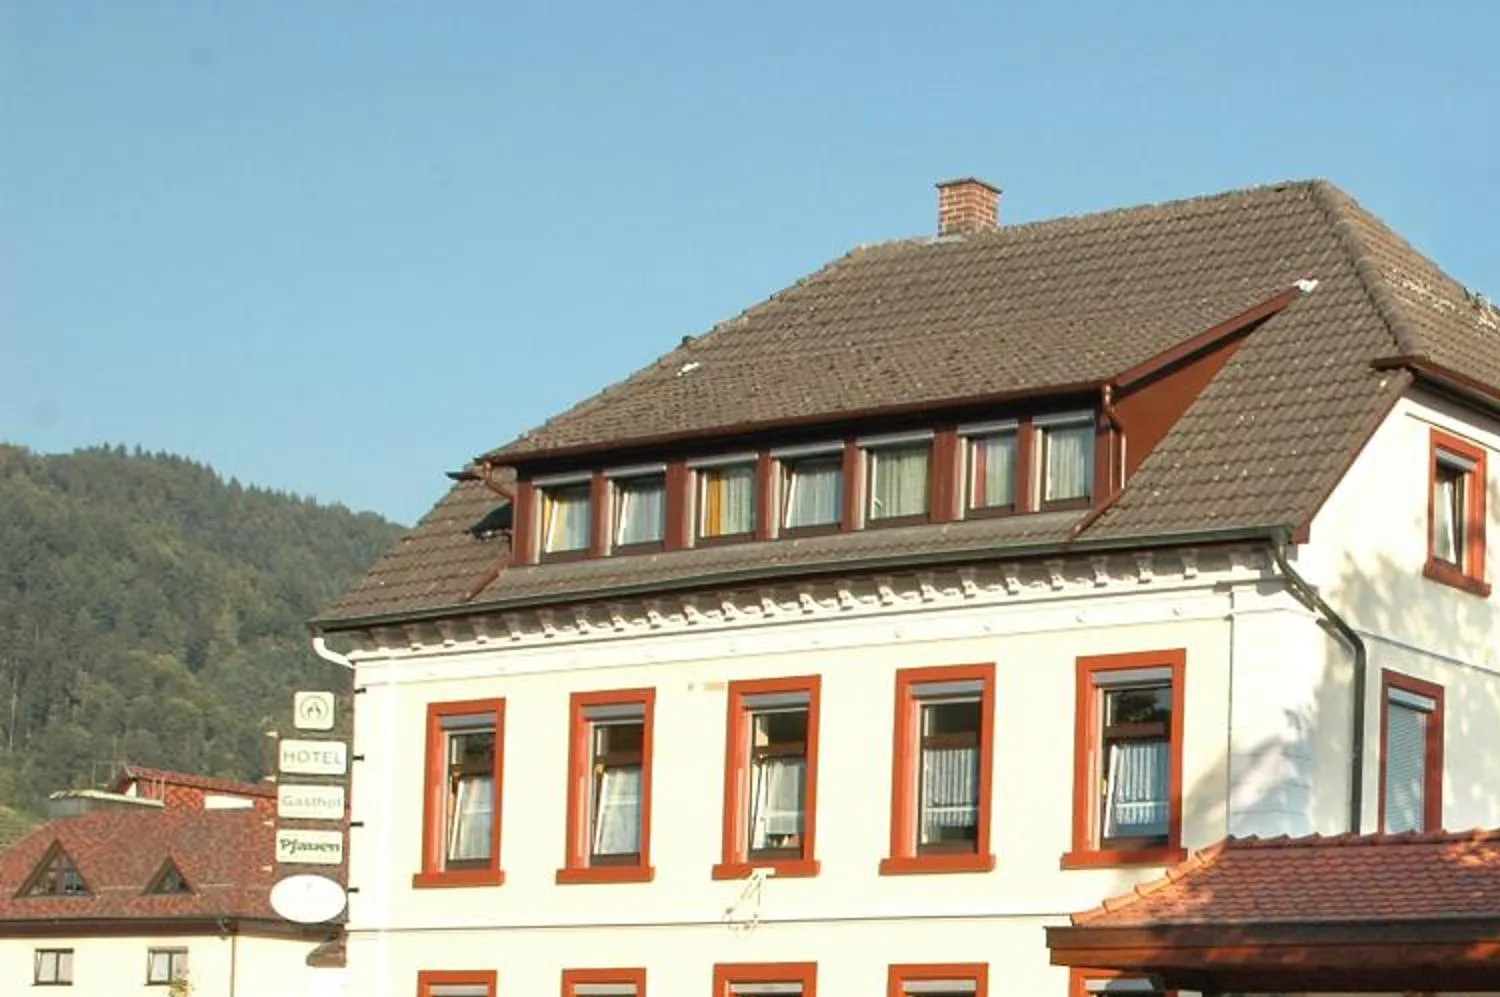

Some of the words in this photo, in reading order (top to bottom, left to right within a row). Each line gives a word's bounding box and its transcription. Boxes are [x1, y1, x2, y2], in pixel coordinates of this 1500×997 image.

[283, 750, 343, 765] HOTEL
[282, 795, 341, 809] Gasthof
[279, 838, 341, 855] Pfauen
